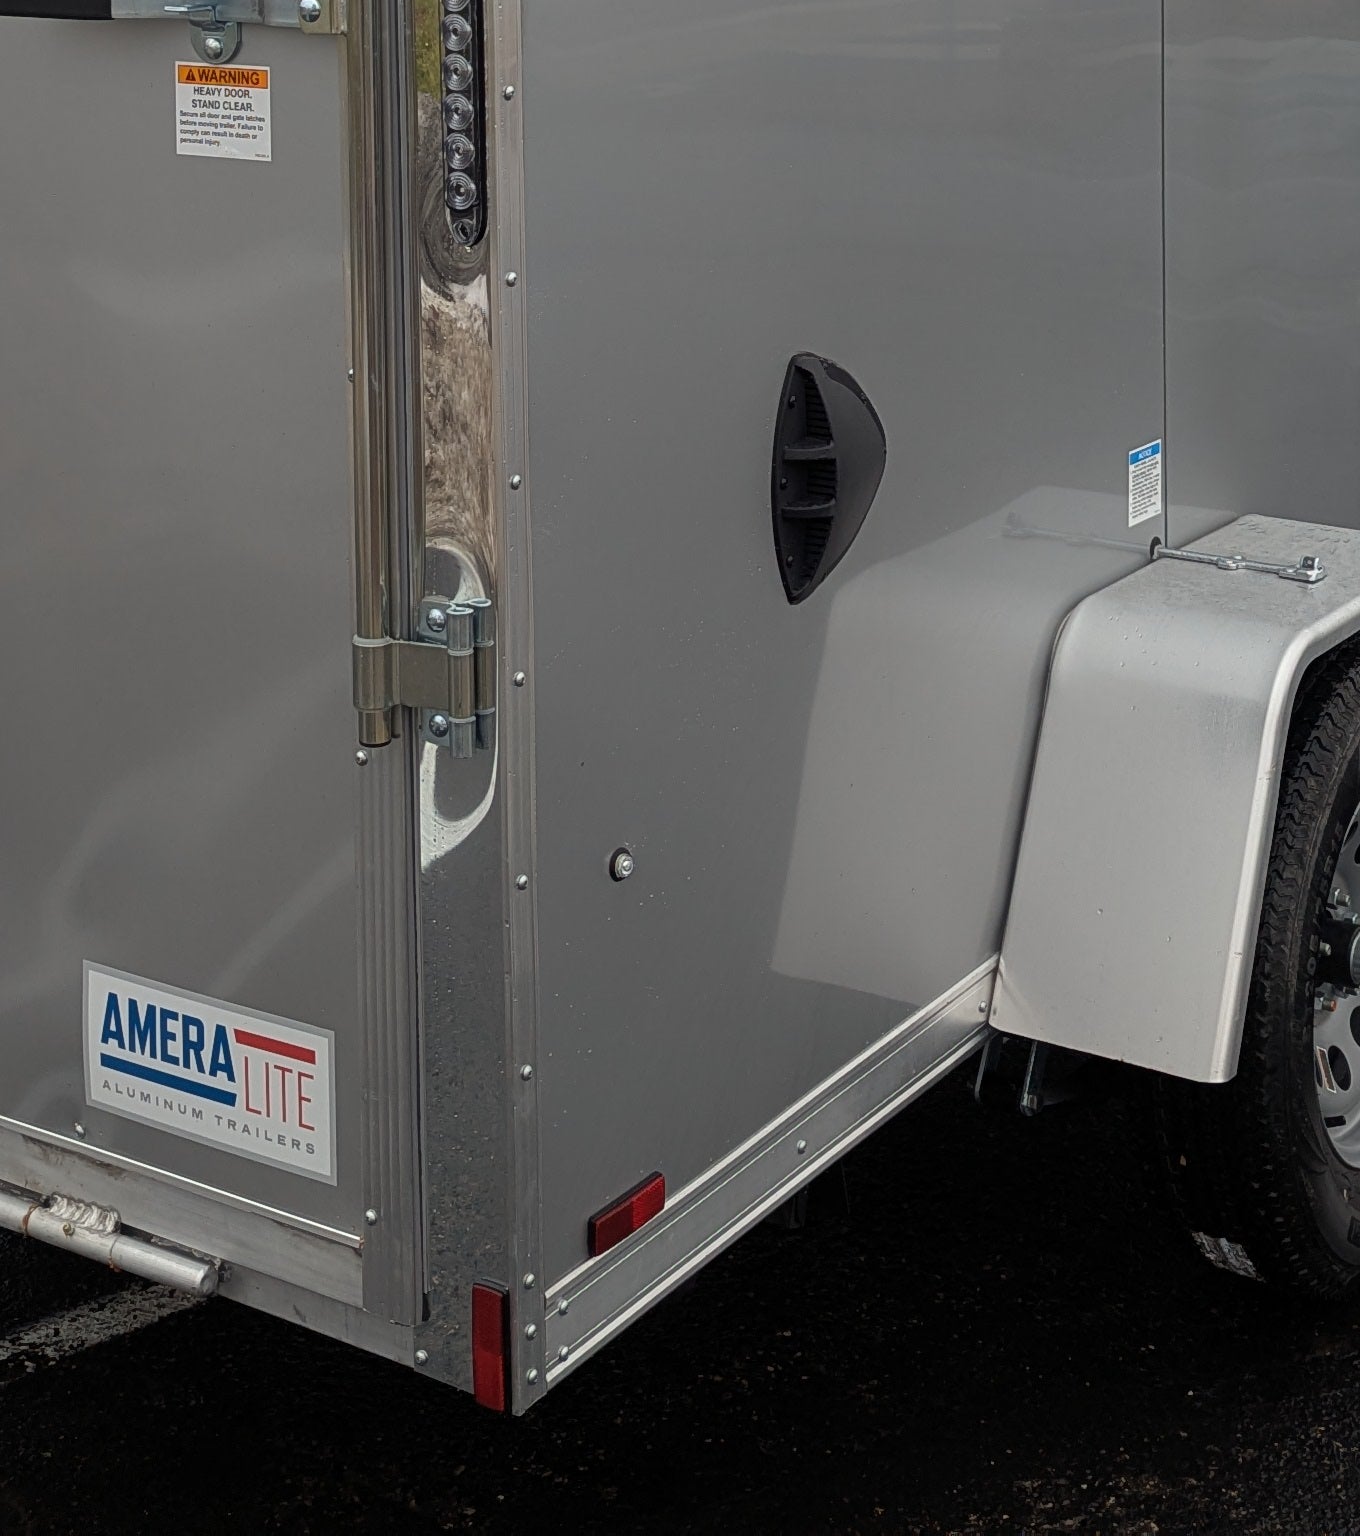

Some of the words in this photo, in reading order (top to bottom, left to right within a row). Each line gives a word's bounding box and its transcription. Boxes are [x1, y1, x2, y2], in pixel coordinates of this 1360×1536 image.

[198, 69, 260, 85] WARNING
[194, 87, 222, 96] HEAVY
[225, 89, 252, 99] DOOR.
[192, 99, 220, 109] STAND
[223, 101, 254, 112] CLEAR.
[102, 1080, 203, 1121] ALUMINUM
[214, 1115, 316, 1154] TRAILERS
